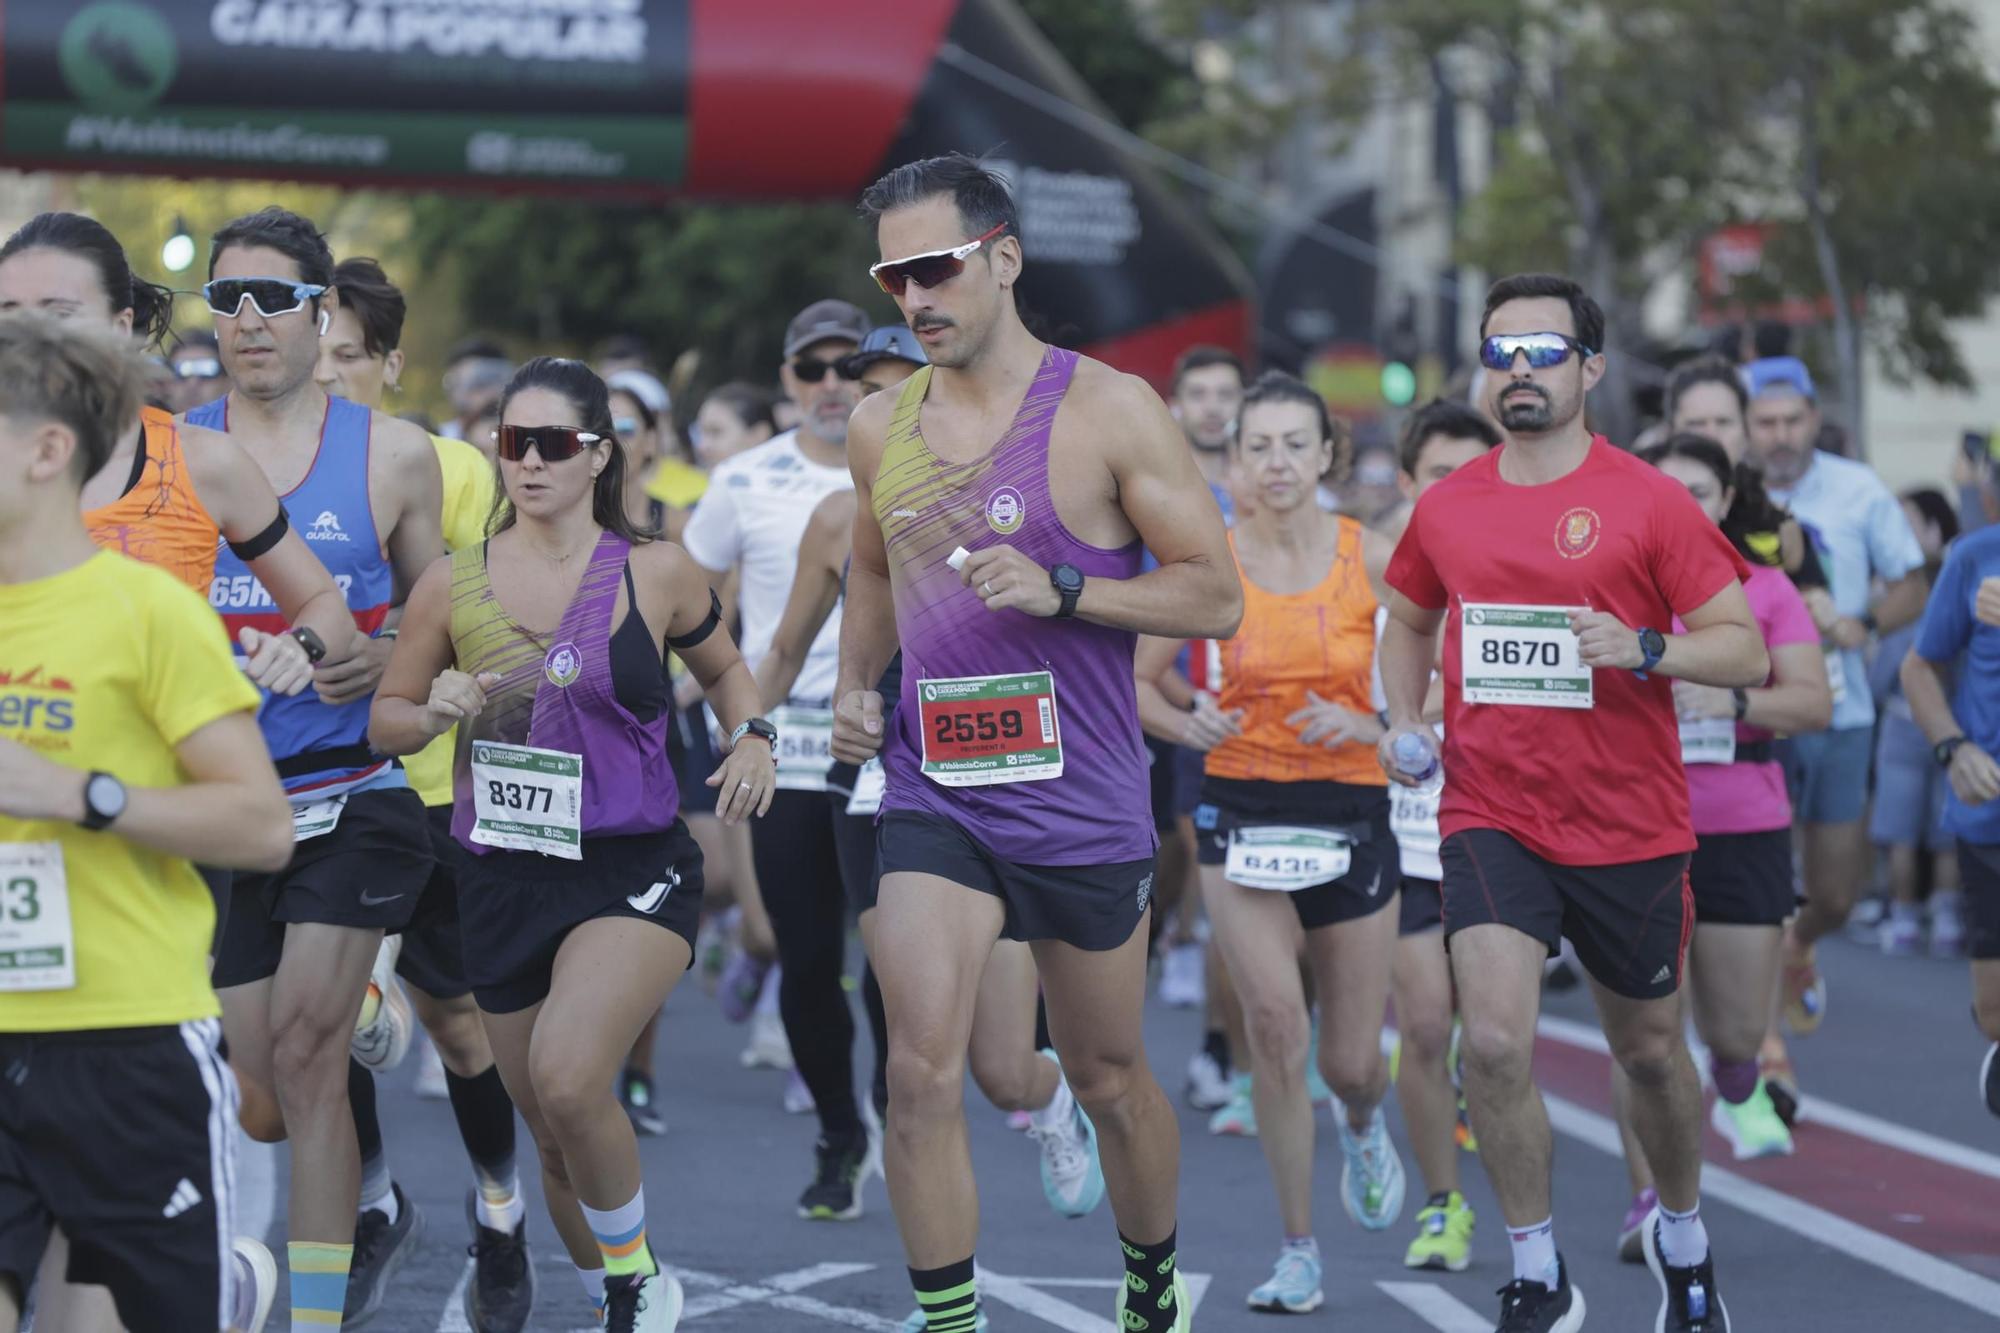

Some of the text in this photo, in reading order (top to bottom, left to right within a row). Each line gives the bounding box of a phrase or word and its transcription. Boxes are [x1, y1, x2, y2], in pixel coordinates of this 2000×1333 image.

[210, 2, 648, 63] CAIXA POPULAR
[1482, 639, 1560, 666] 8670
[0, 695, 73, 731] ers
[935, 709, 1023, 743] 2559
[489, 780, 553, 813] 8377
